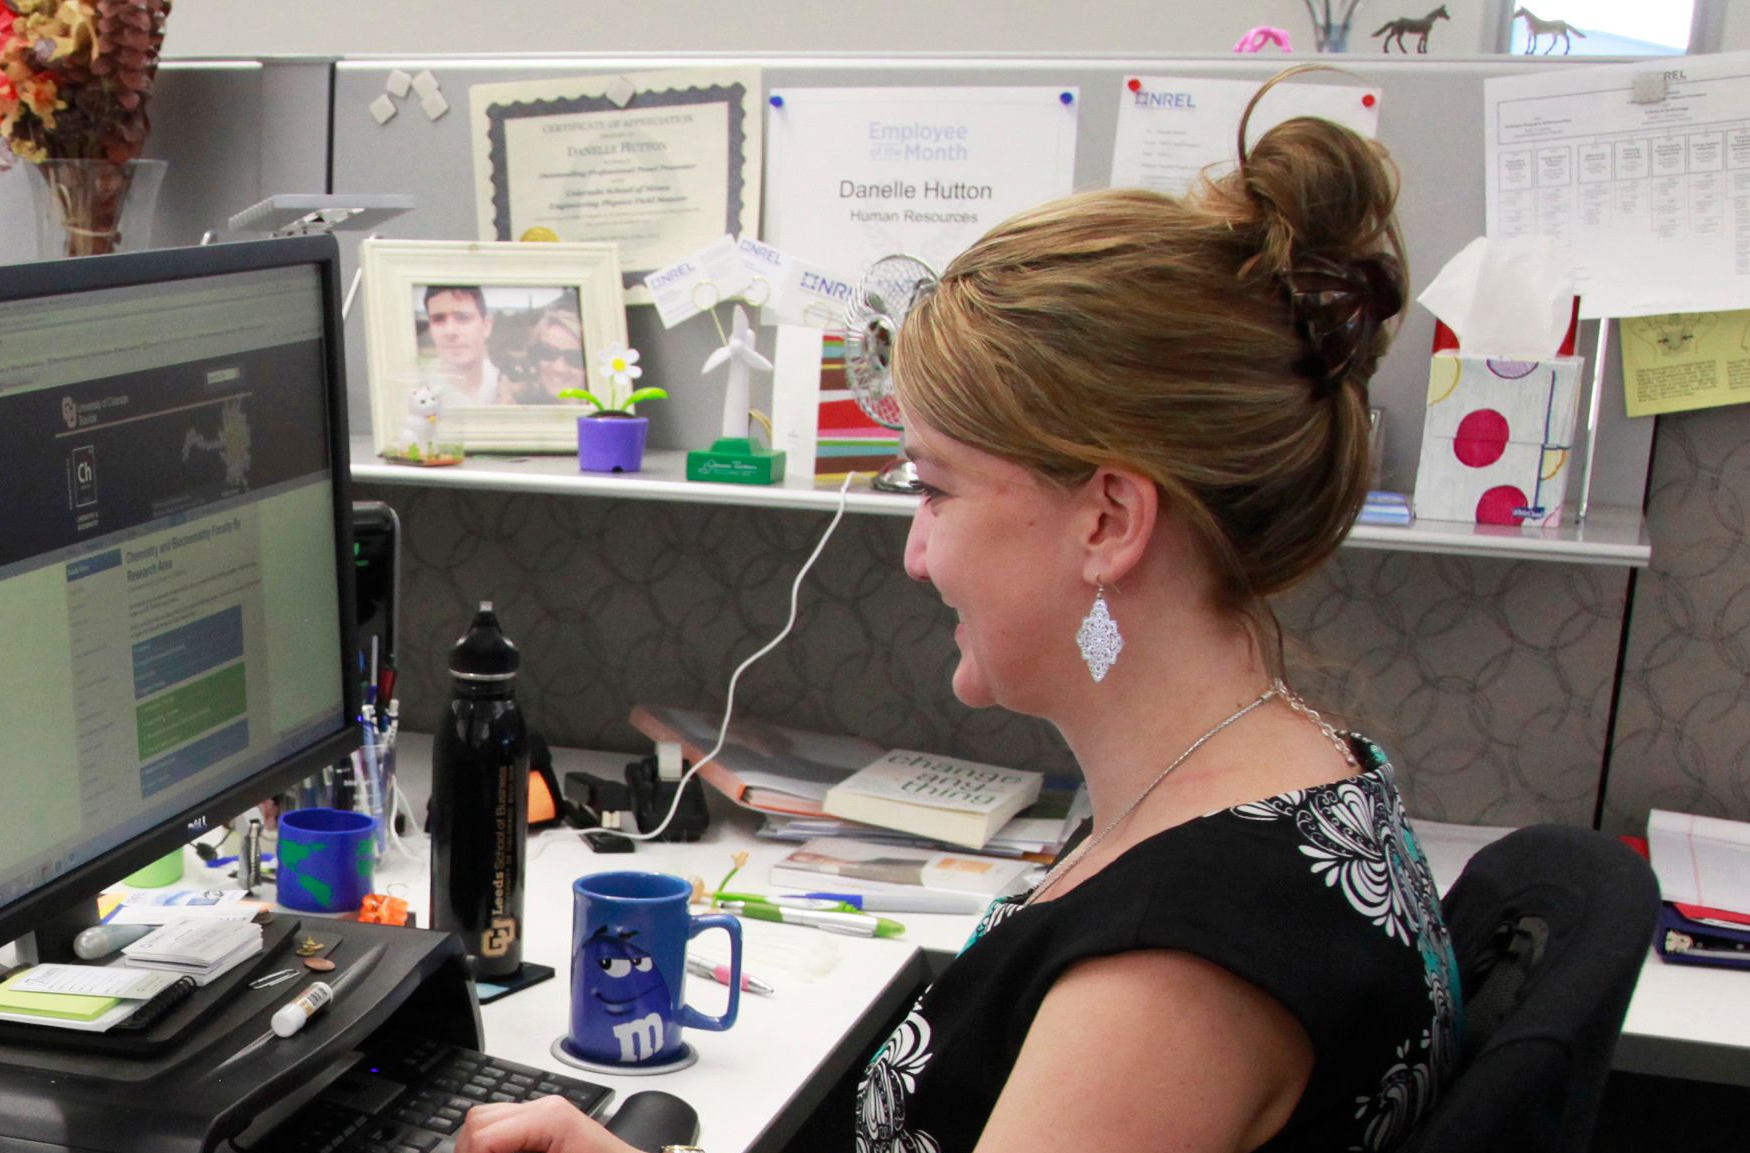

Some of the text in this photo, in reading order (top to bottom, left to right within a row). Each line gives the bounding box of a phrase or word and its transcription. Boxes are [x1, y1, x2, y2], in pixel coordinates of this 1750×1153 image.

[1662, 69, 1687, 81] REL
[1150, 92, 1196, 109] NREL
[868, 121, 968, 142] Employee
[567, 144, 618, 157] DANELLE
[904, 143, 968, 161] Month
[839, 179, 993, 200] Danelle Hutton
[849, 209, 979, 224] Human Resources
[750, 242, 783, 266] NREL
[660, 262, 696, 284] NREL
[77, 461, 92, 483] Ch
[126, 562, 157, 582] Research
[887, 755, 1022, 785] change
[495, 766, 508, 817] Business
[900, 780, 996, 805] thing
[916, 772, 986, 792] any
[493, 831, 506, 870] School
[491, 870, 504, 916] Leeds
[612, 1012, 665, 1062] m
